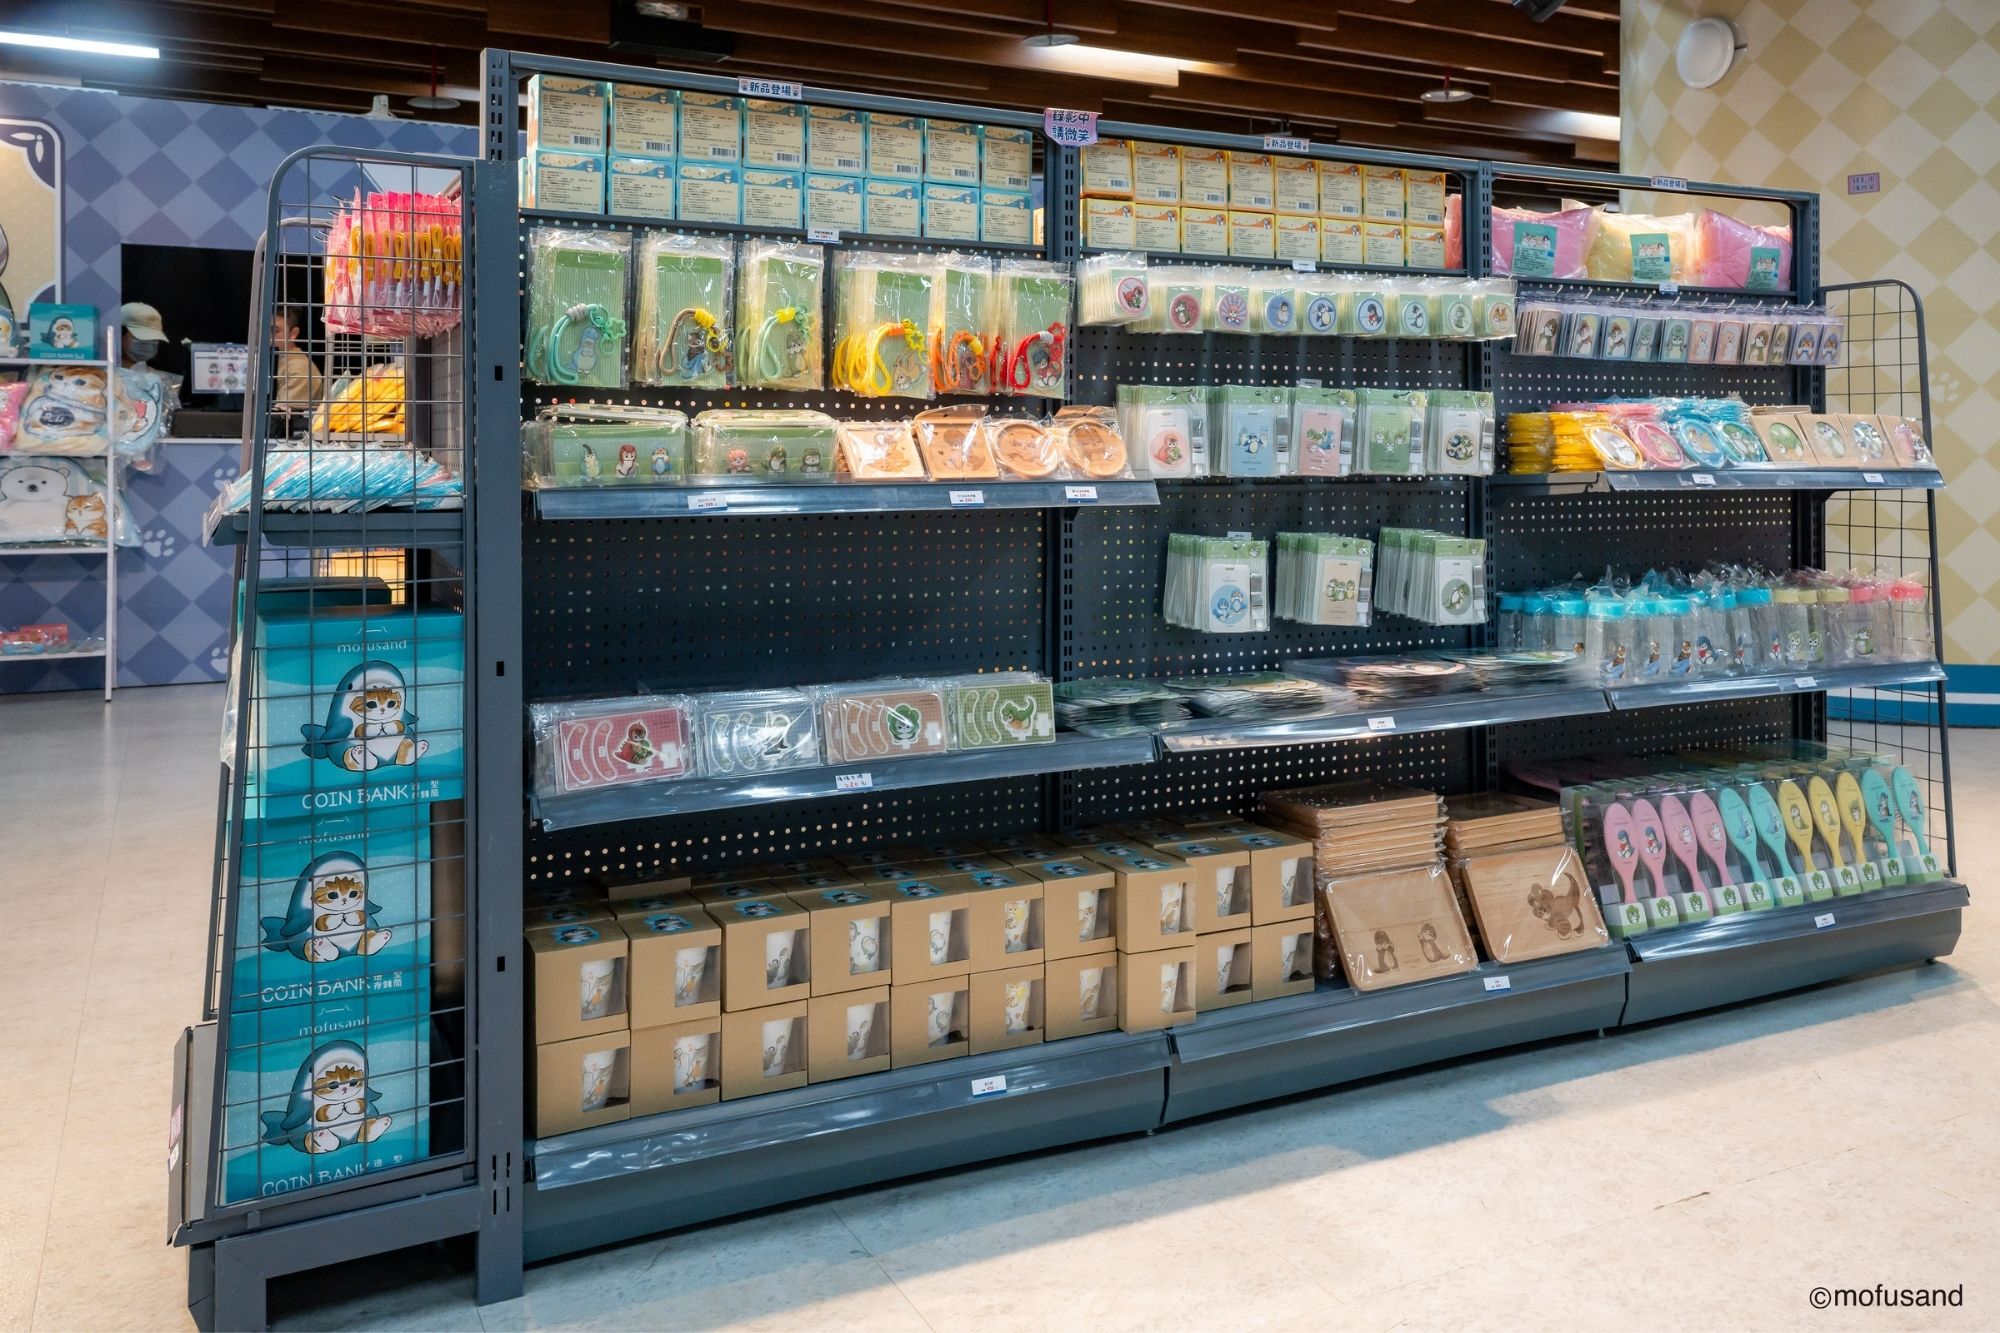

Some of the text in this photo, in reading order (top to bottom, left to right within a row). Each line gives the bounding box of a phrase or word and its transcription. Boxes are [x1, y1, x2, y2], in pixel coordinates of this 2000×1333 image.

[750, 81, 791, 96] 新品登場
[1052, 126, 1089, 142] 請微笑
[1272, 139, 1302, 149] 新品登場
[302, 784, 409, 809] COIN BANK
[261, 977, 370, 1002] COIN BANK
